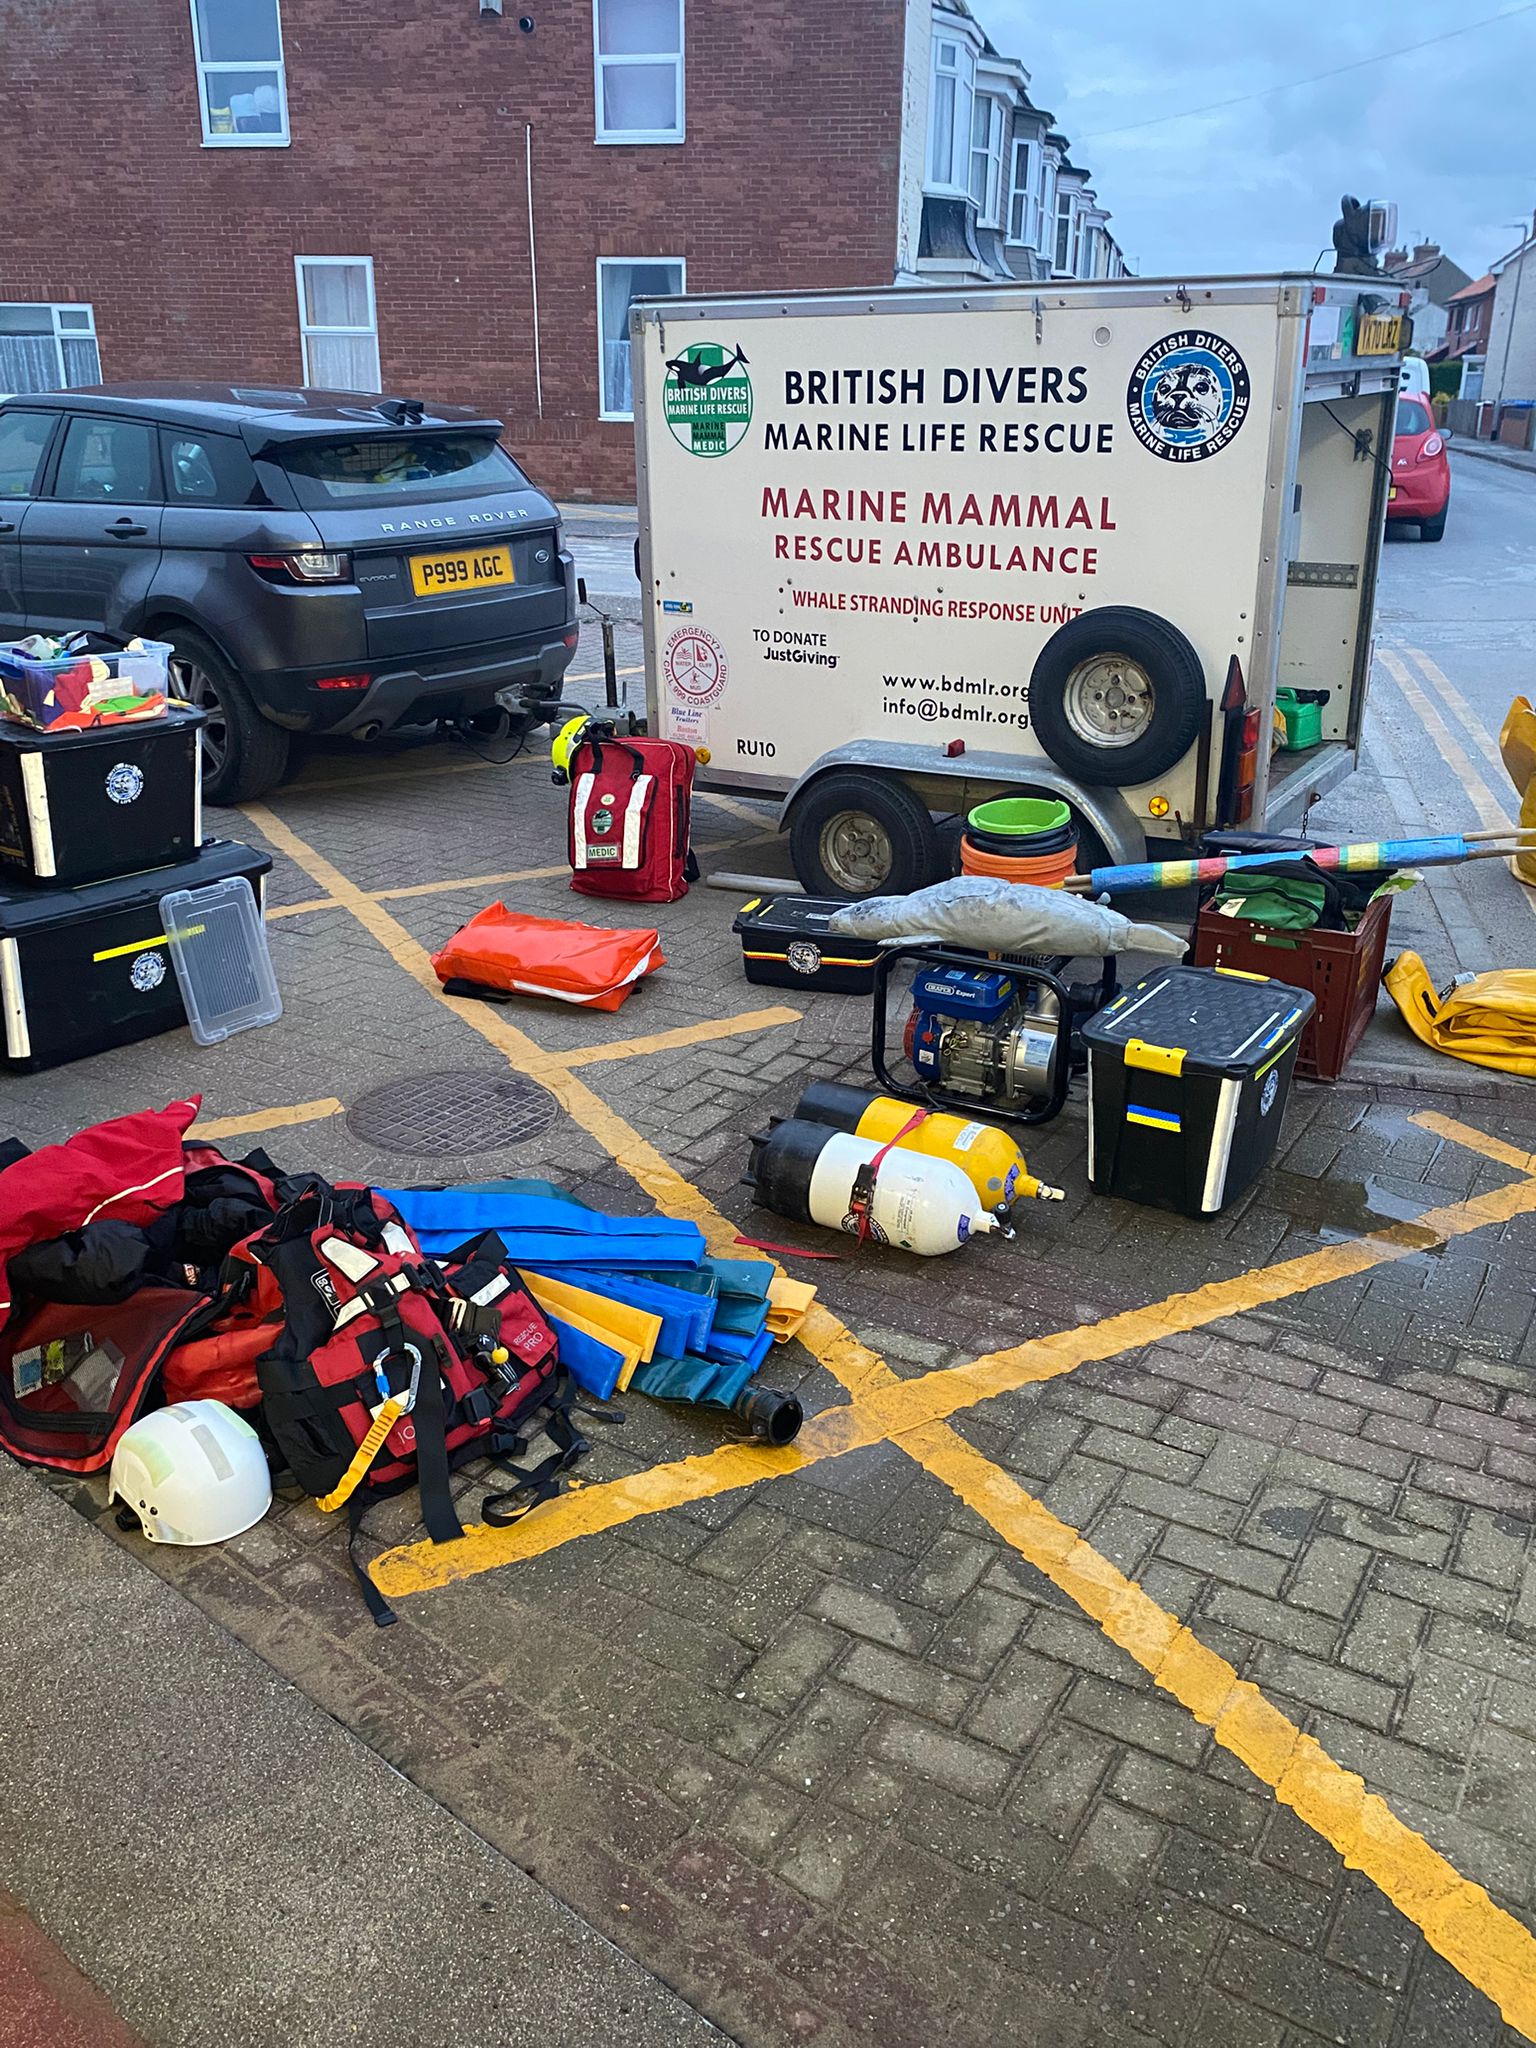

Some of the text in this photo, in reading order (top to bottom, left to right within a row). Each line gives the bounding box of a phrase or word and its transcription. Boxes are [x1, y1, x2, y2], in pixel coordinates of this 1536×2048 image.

[1135, 334, 1243, 380] BRITISH DIVERS
[667, 386, 747, 402] BRITISH DIVERS
[785, 366, 1088, 404] BRITISH DIVERS
[668, 403, 748, 415] MARINE LIFE RESCUE
[692, 422, 725, 431] MARINE
[692, 431, 726, 440] MAMMAL
[764, 423, 1114, 453] MARINE LIFE RESCUE
[1129, 396, 1248, 460] MARINE LIFE RESCUE
[693, 441, 726, 451] MEDIC
[380, 508, 529, 533] RANGE ROVER
[761, 487, 1116, 530] MARINE MAMMAL
[775, 535, 1098, 575] RESCUE AMBULANCE
[422, 555, 504, 586] P999 AGC
[793, 590, 847, 610] WHALE
[850, 594, 944, 617] STRANDING
[948, 600, 1035, 623] RESPONSE
[667, 627, 721, 652] EMERGENCY?
[753, 629, 828, 647] TO DONATE
[764, 647, 838, 669] JustGiving
[663, 660, 728, 706] CALL 999 COASTGUARD
[883, 674, 1030, 703] www.bdmlr.org
[671, 706, 703, 718] Blue Line
[883, 696, 1030, 730] info@bdmlr.org
[737, 738, 776, 758] RU10
[588, 847, 616, 857] MEDIC
[513, 1321, 538, 1346] RESCUE
[523, 1332, 544, 1351] PRO
